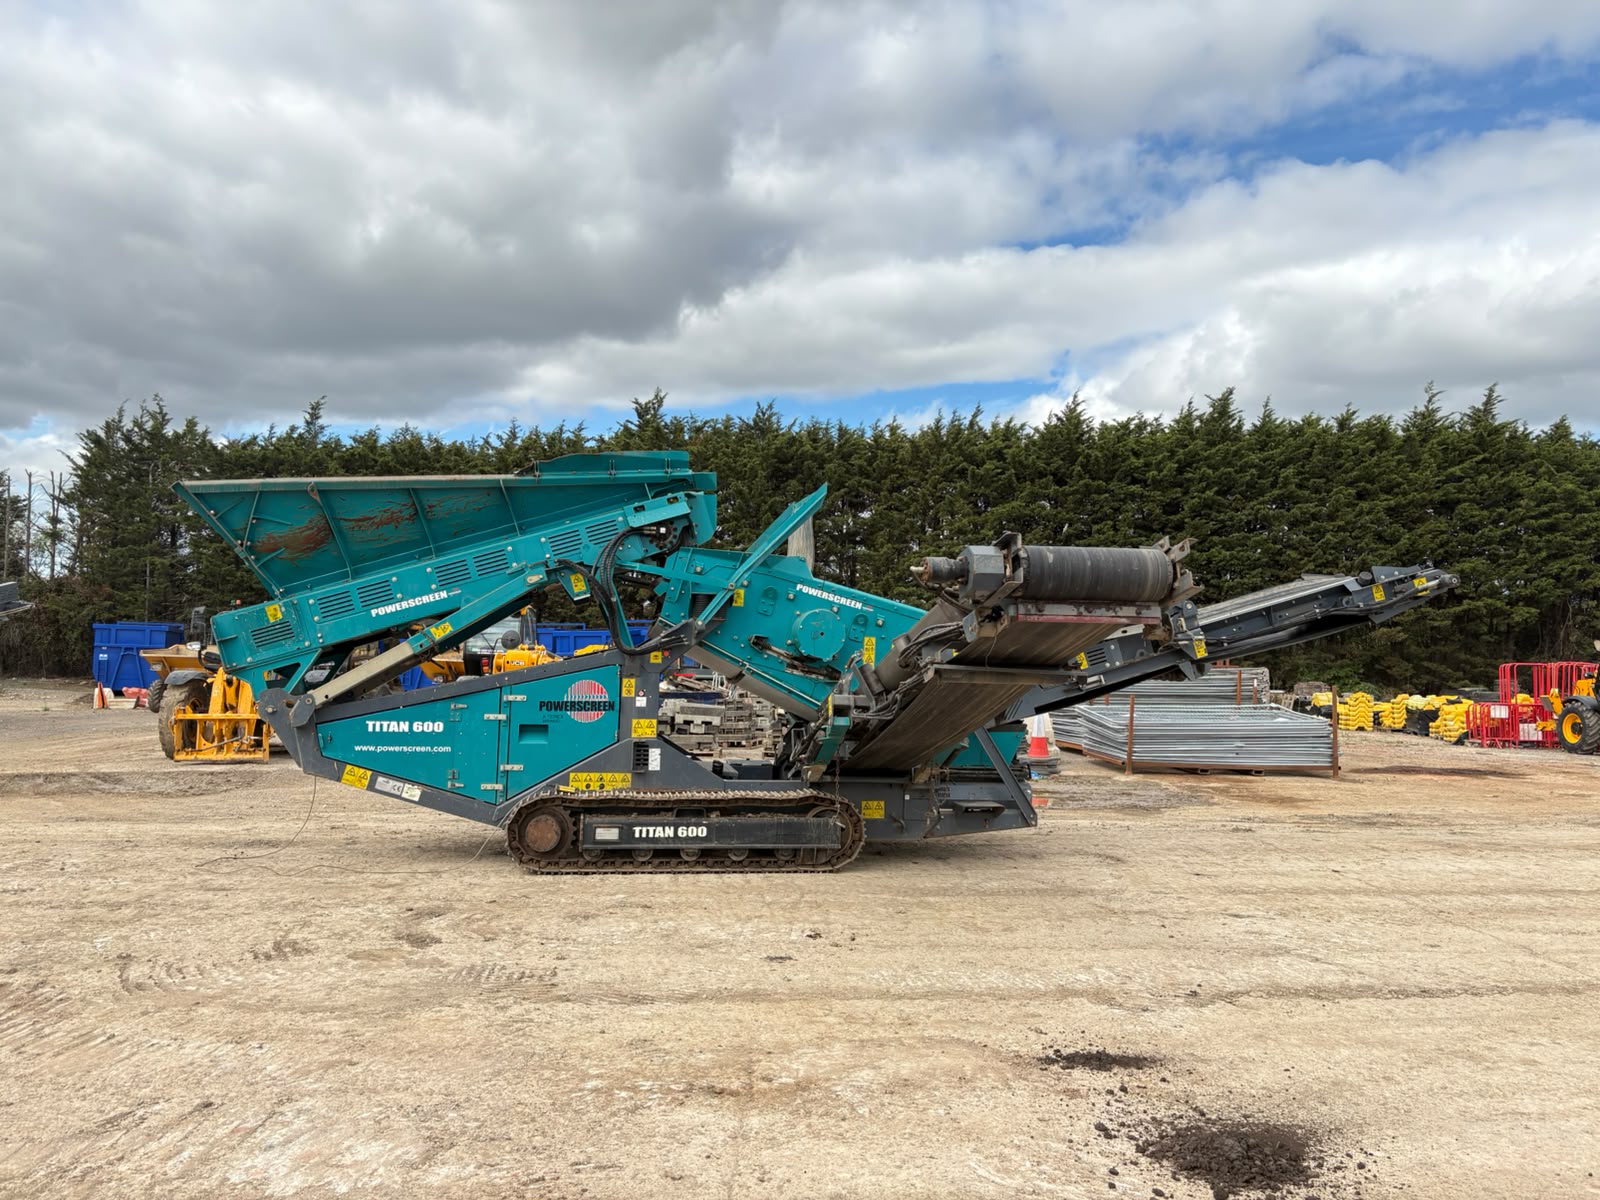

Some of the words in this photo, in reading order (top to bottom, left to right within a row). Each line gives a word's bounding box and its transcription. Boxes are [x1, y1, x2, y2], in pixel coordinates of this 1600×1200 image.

[796, 583, 863, 610] POWERSCREEN
[370, 590, 448, 617] POWERSCREEN
[539, 700, 615, 712] POWERSCREEN
[365, 720, 410, 733] TITAN
[412, 720, 444, 733] 600
[354, 745, 451, 753] www.powerscreen.com
[632, 826, 674, 838] TITAN
[677, 825, 708, 838] 600
